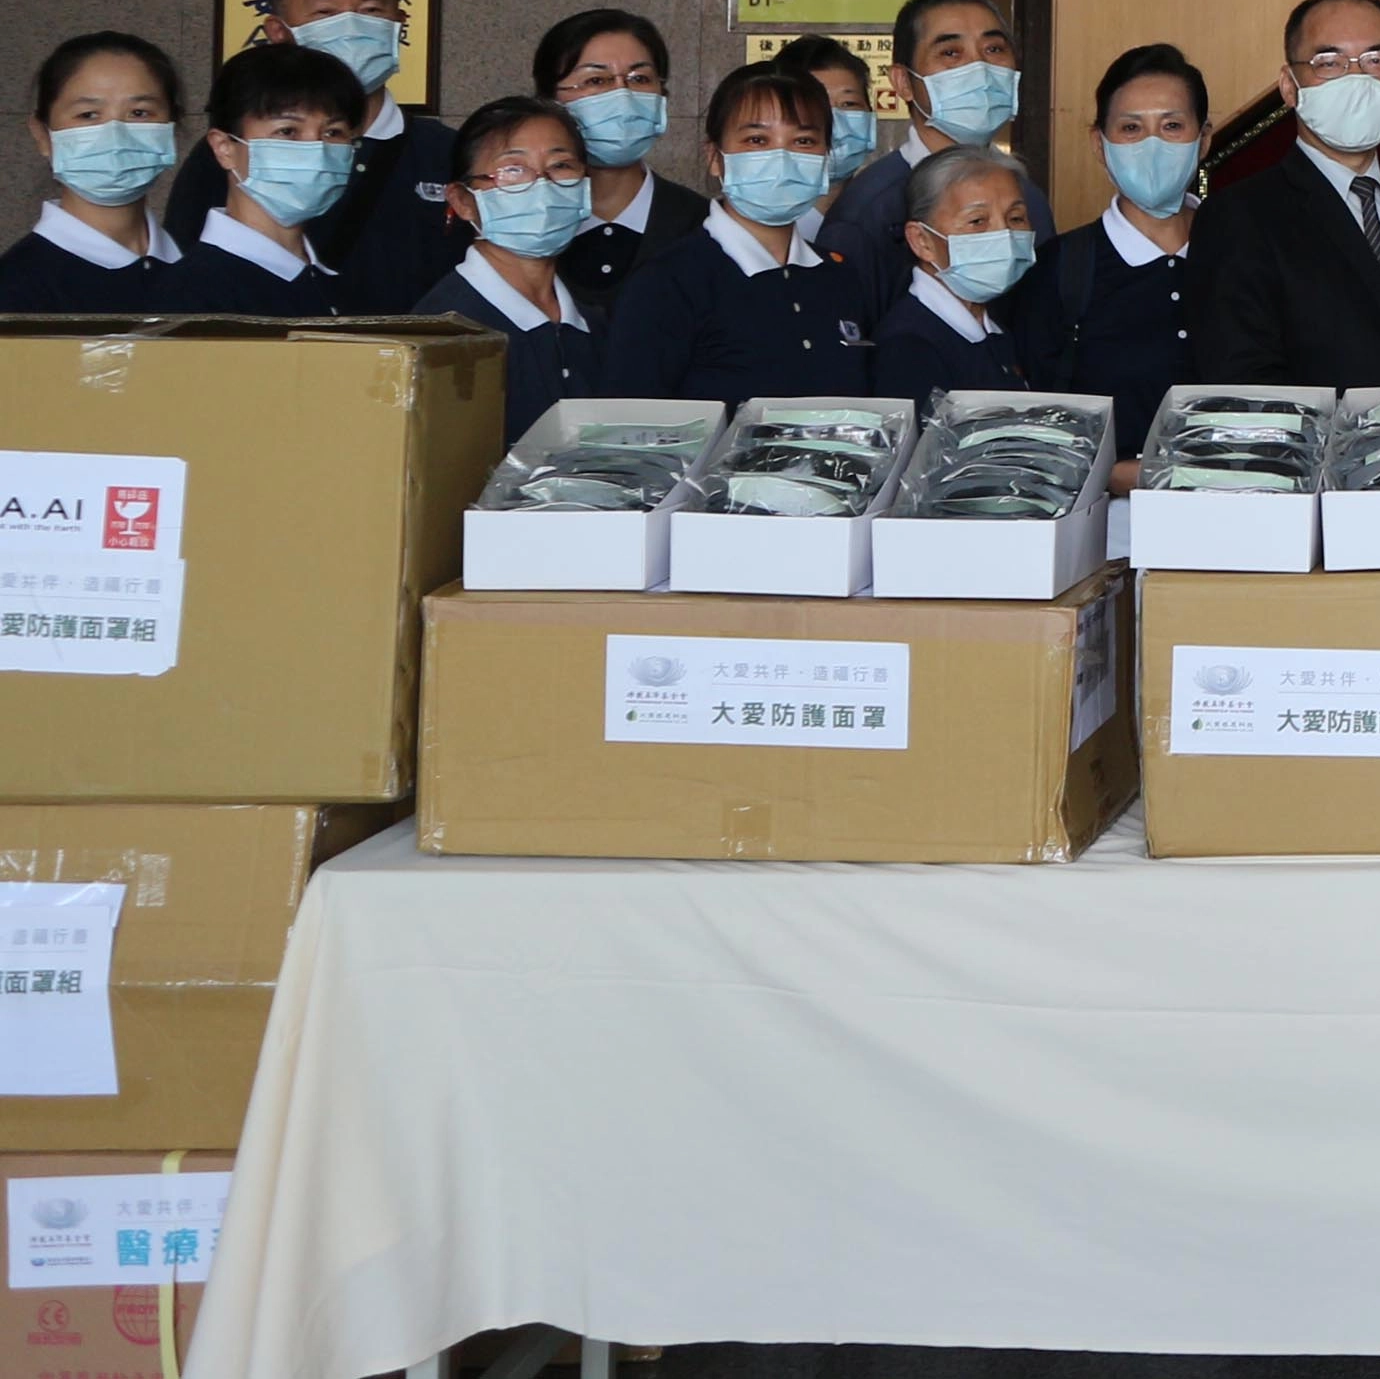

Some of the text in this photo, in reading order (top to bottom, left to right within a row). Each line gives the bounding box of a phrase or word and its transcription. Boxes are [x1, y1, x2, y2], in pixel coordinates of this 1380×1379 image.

[0, 613, 156, 642] 愛防護面罩組
[711, 701, 886, 730] 大愛防護面罩
[0, 969, 83, 994] 面罩組
[117, 1228, 220, 1267] 醫療
